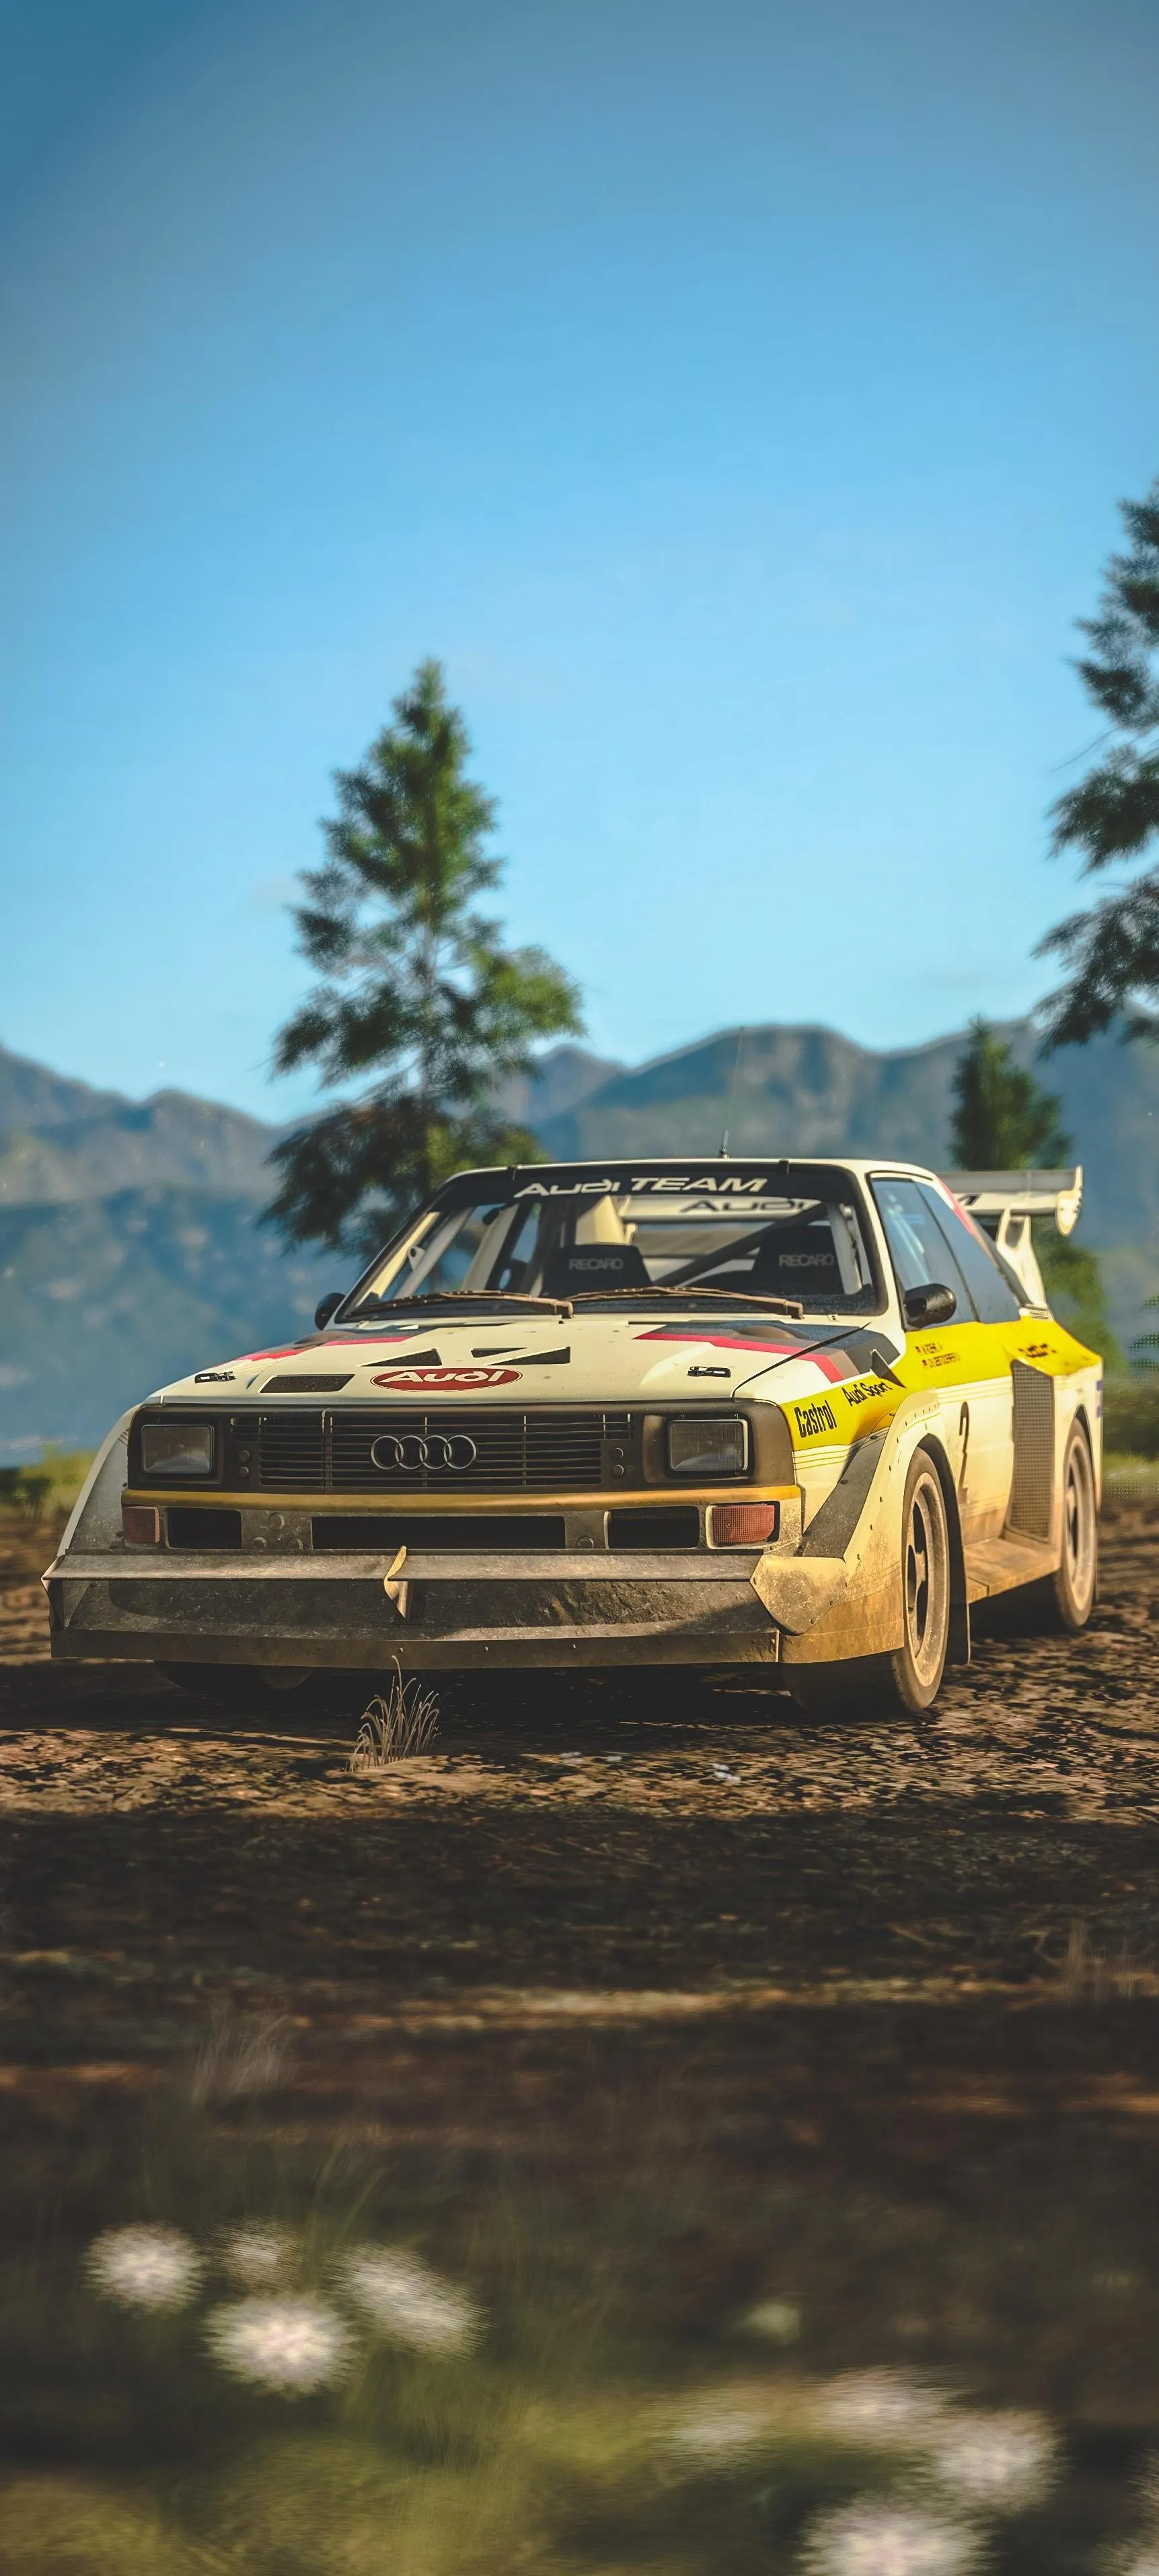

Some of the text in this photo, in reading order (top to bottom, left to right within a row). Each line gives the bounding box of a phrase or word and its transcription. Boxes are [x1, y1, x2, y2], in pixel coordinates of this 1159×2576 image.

[630, 1177, 768, 1192] TEAM
[570, 1258, 623, 1271] RECARO
[778, 1254, 834, 1267] RECARO
[842, 1382, 893, 1406] Audi Sport
[794, 1400, 837, 1438] Castrol
